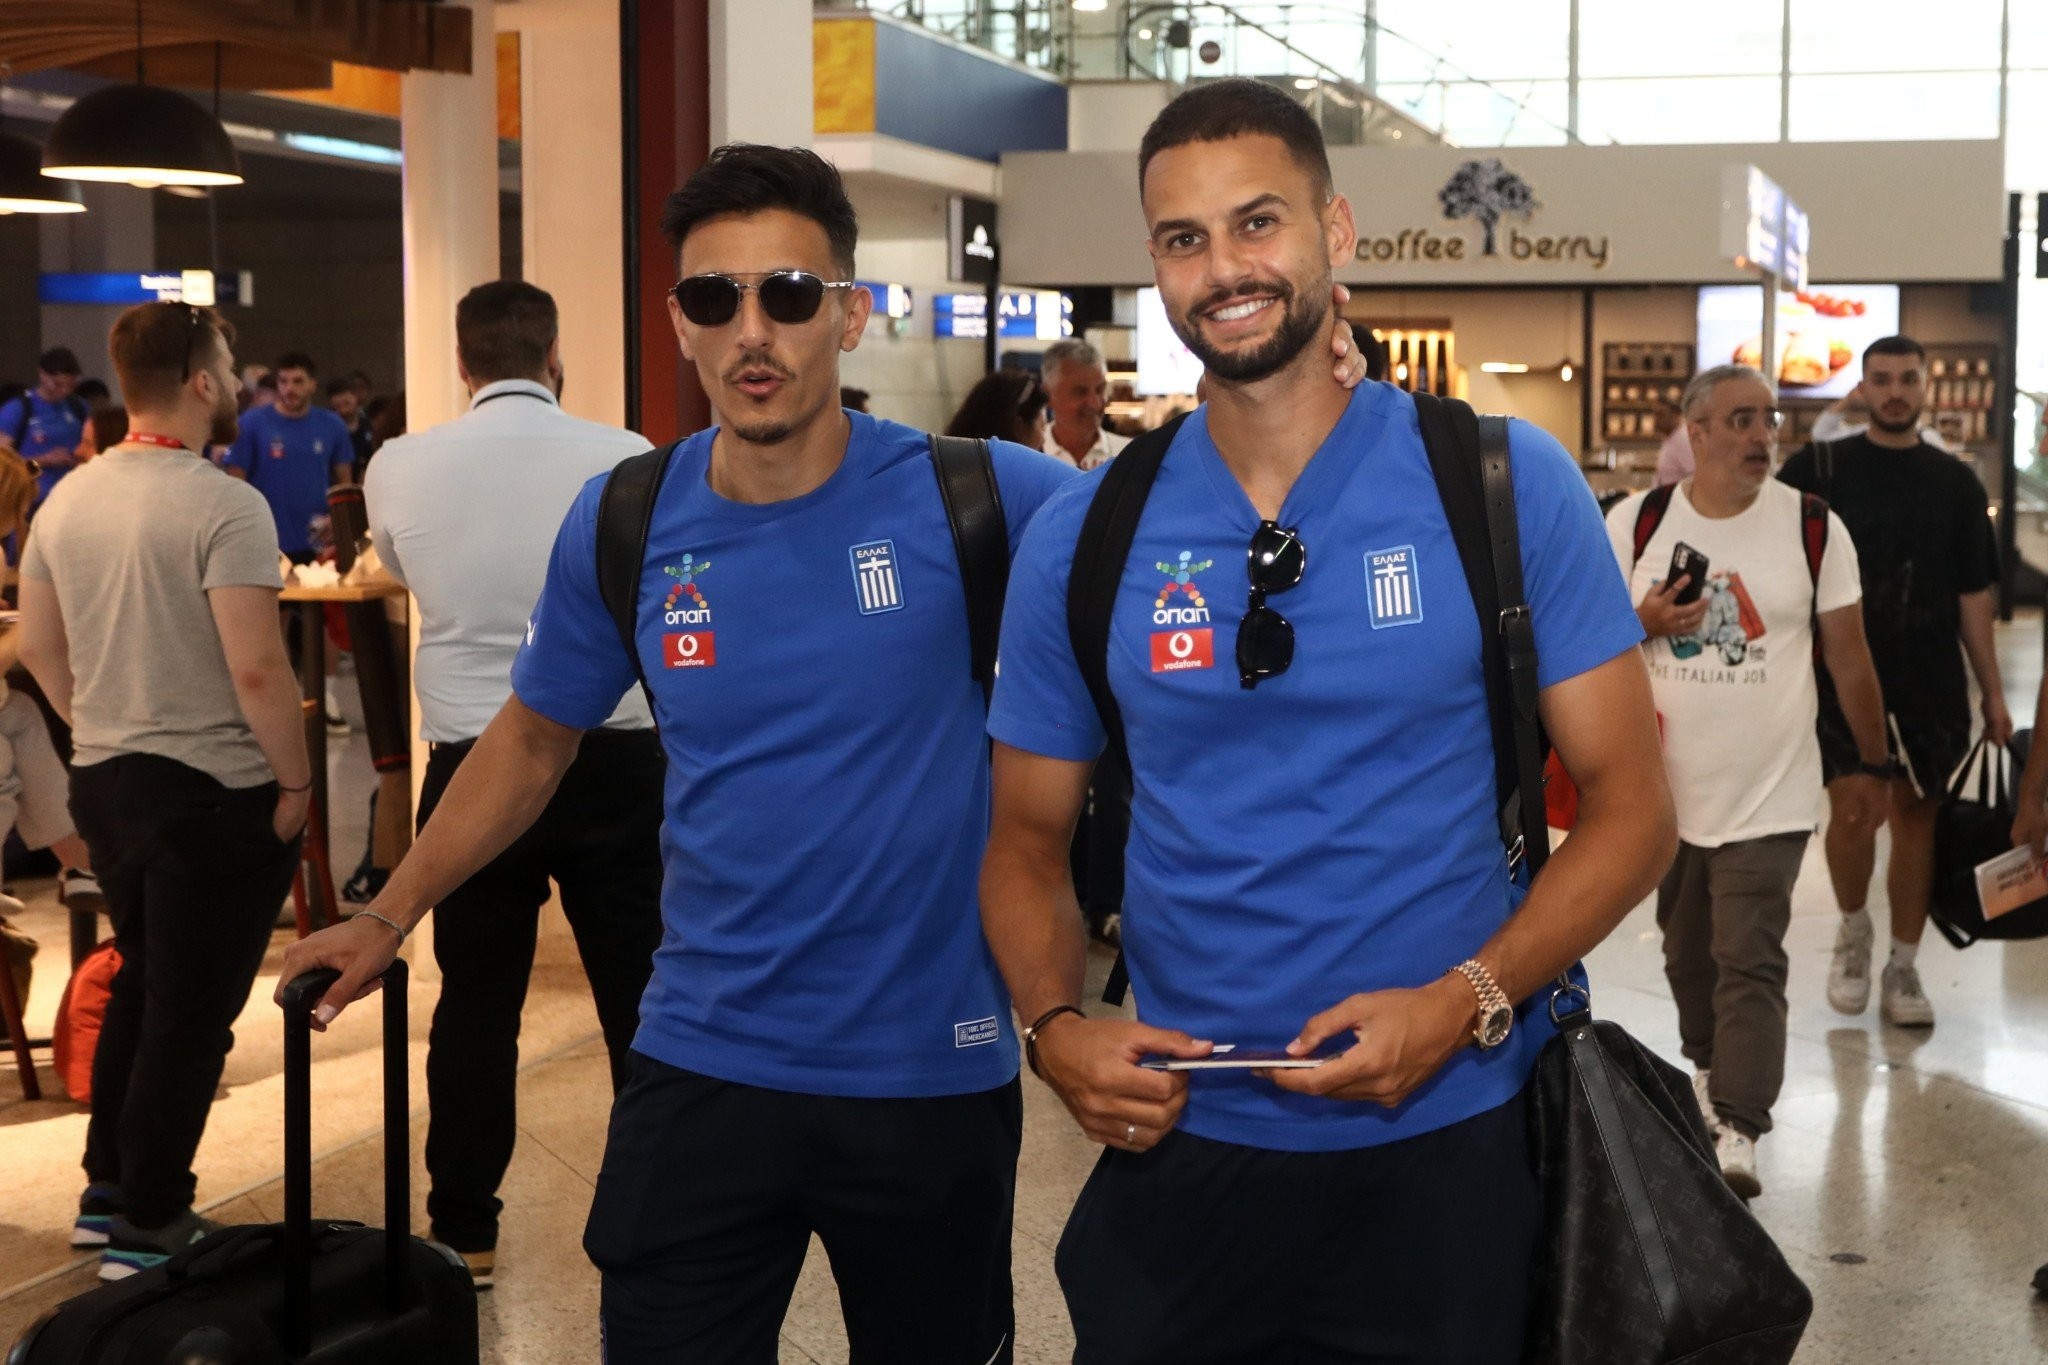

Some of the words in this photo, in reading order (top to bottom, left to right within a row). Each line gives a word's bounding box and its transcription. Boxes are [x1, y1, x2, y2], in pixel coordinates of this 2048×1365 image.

[1355, 229, 1465, 261] coffee
[1509, 227, 1608, 270] berry
[856, 546, 889, 559] ΕΛΛΑΣ
[1373, 552, 1407, 566] ΕΛΛΑΣ
[673, 658, 705, 667] vodafone
[1163, 659, 1202, 671] vodafone
[1674, 666, 1736, 684] ITALIAN
[1743, 667, 1768, 684] JOB
